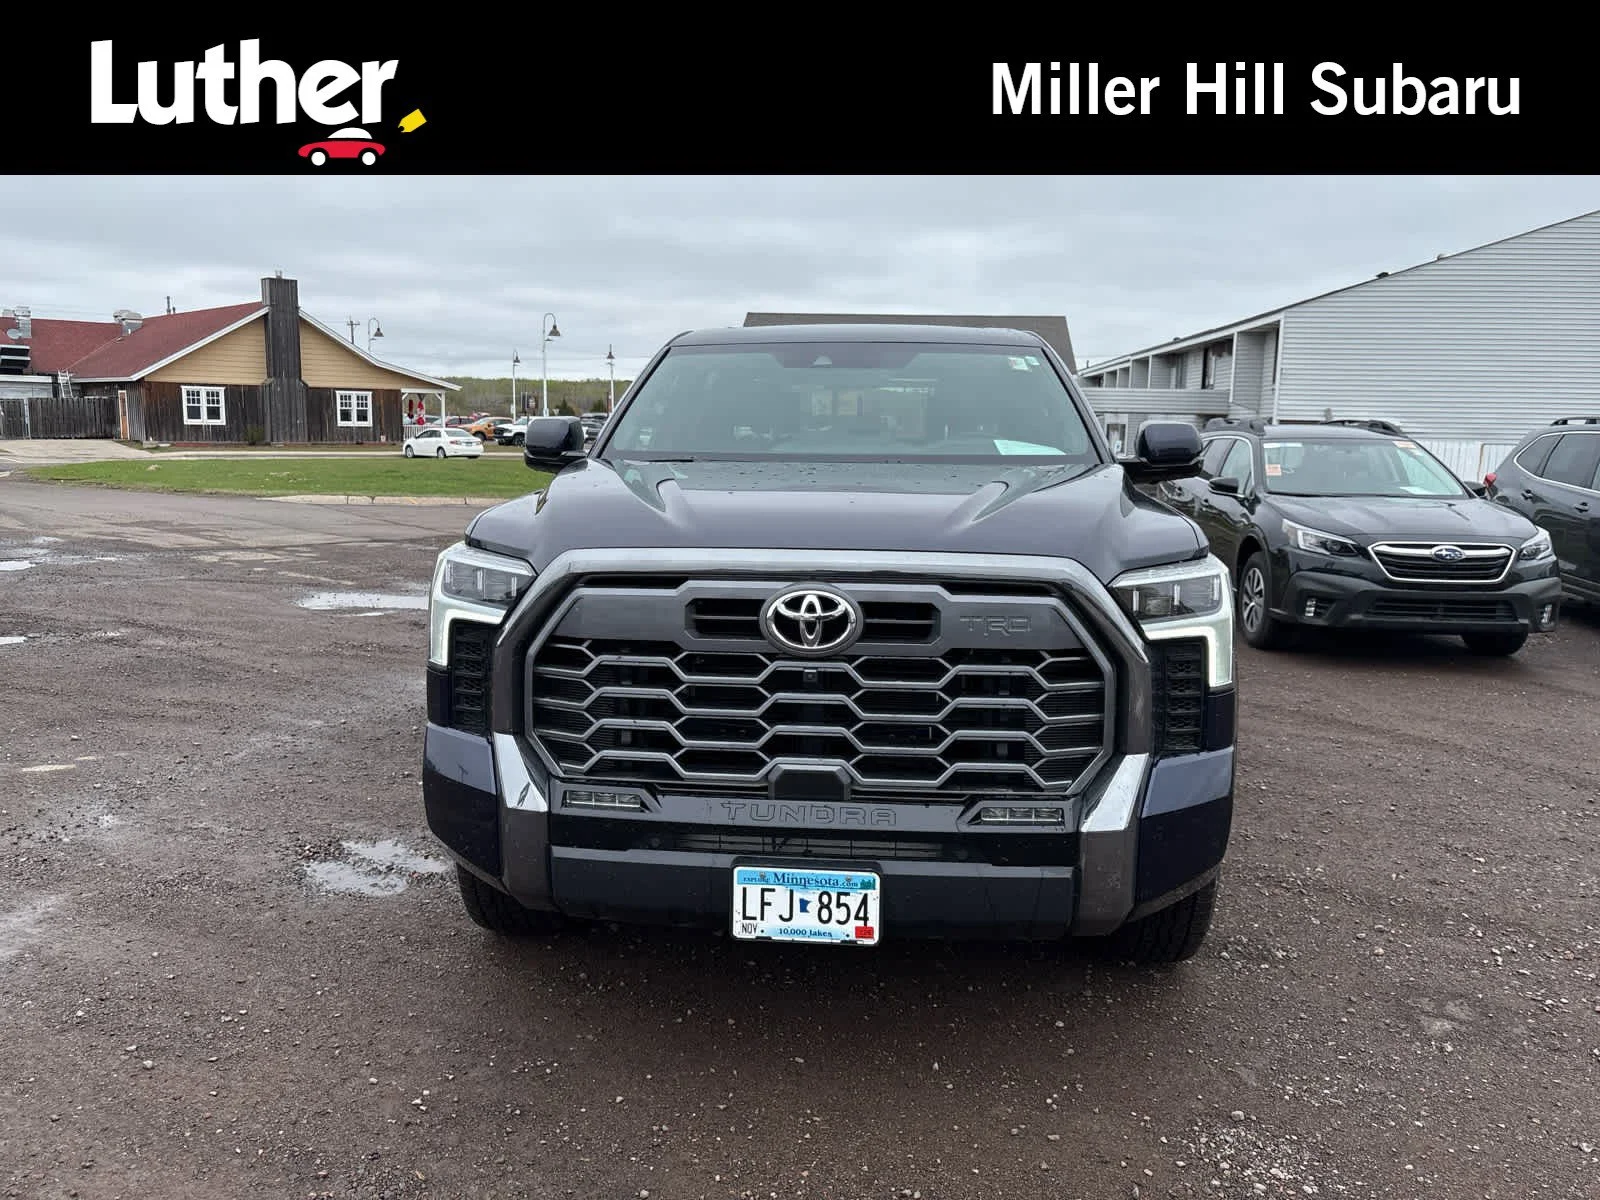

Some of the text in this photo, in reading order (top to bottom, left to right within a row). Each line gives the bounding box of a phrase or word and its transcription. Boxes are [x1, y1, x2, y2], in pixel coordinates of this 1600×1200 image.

[959, 615, 1032, 637] TRD
[720, 801, 897, 826] TUNDRA
[741, 922, 758, 934] NOV
[779, 927, 833, 938] 10,000 lakes
